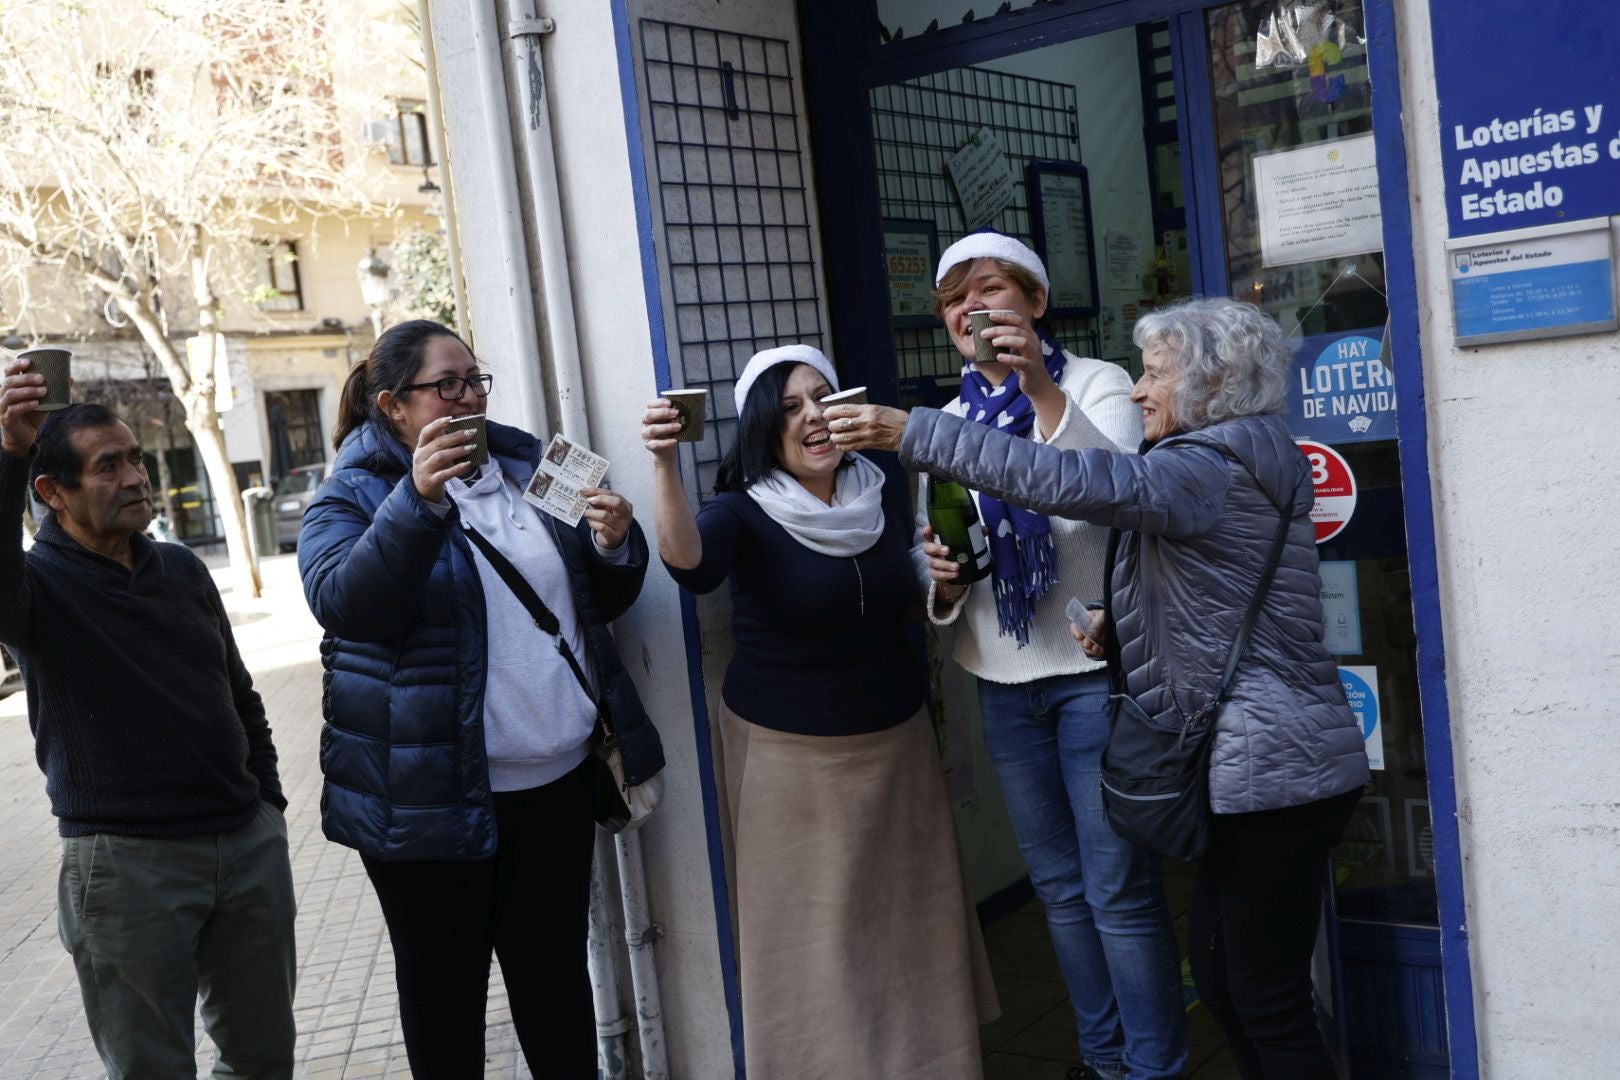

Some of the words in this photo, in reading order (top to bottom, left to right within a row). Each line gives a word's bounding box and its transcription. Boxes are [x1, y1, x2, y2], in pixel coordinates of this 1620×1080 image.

[1455, 108, 1576, 150] Loterías
[1584, 104, 1603, 134] y
[1460, 142, 1599, 188] Apuestas
[1461, 181, 1563, 221] Estado
[890, 256, 928, 275] 65253
[1338, 341, 1367, 359] HAY
[1303, 398, 1326, 419] DE
[1309, 453, 1329, 484] 8
